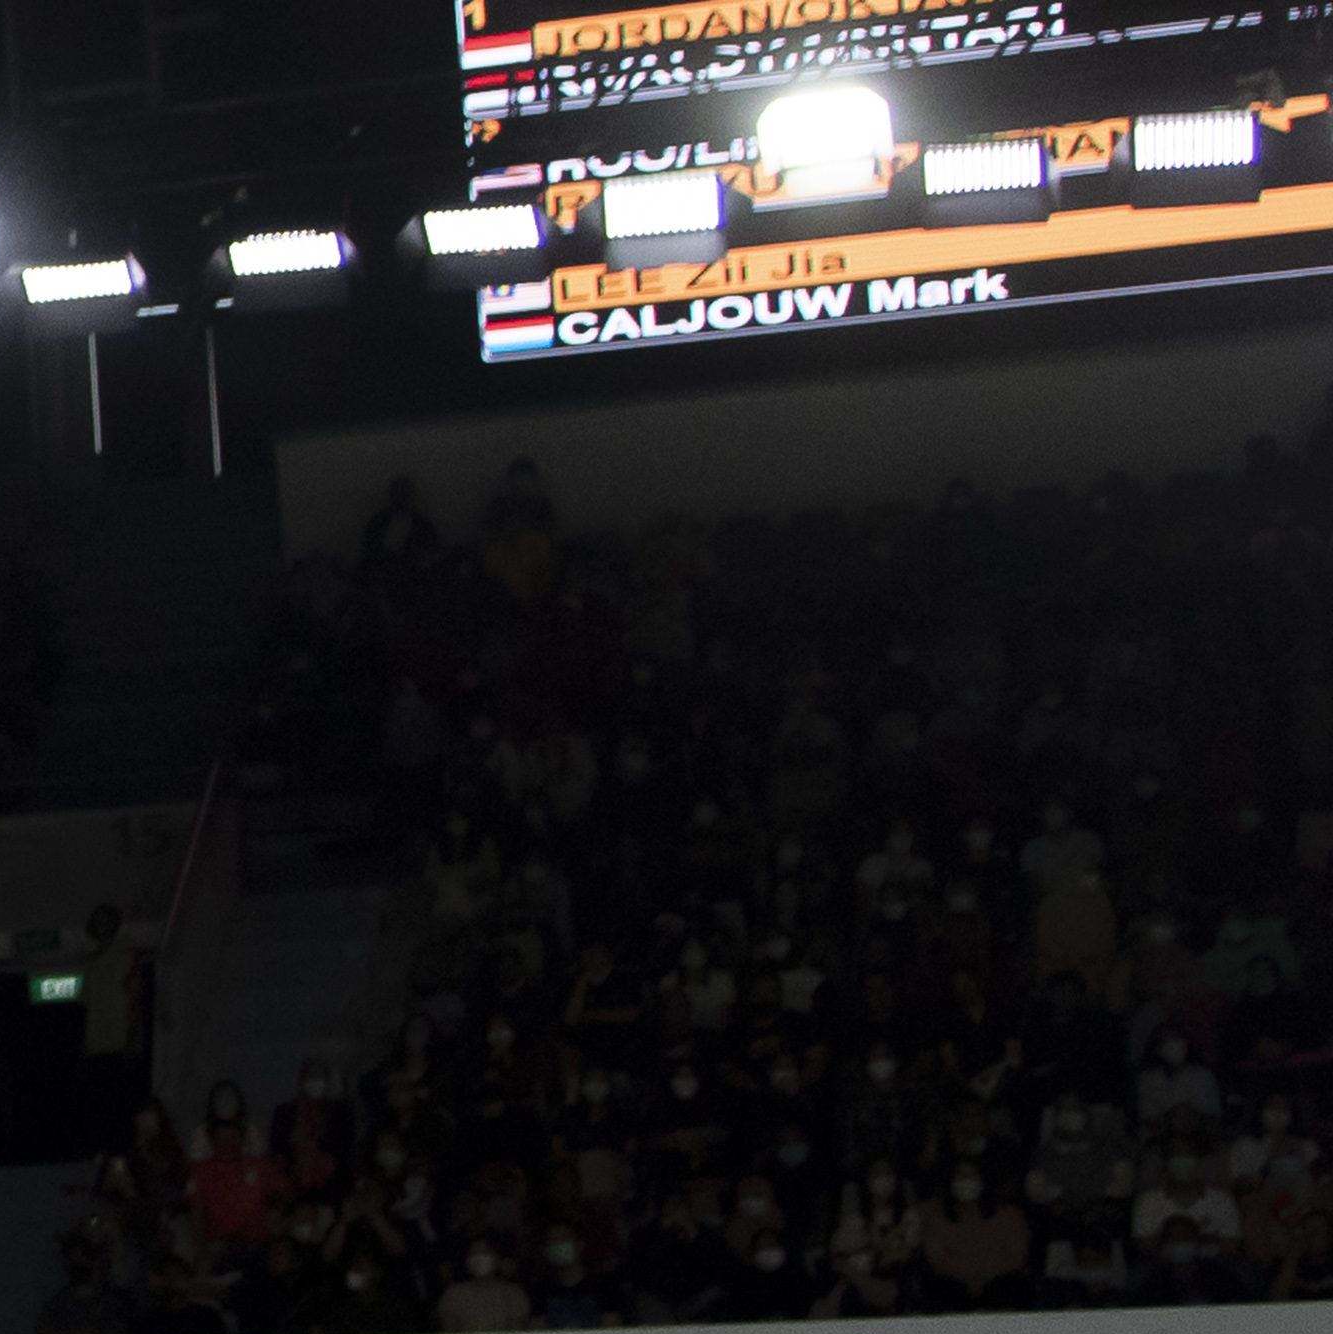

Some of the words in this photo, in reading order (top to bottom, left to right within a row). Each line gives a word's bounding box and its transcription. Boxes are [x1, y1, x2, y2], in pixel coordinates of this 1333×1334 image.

[771, 248, 848, 281] Jia
[557, 283, 853, 346] CALJOUW
[867, 268, 1010, 313] Mark
